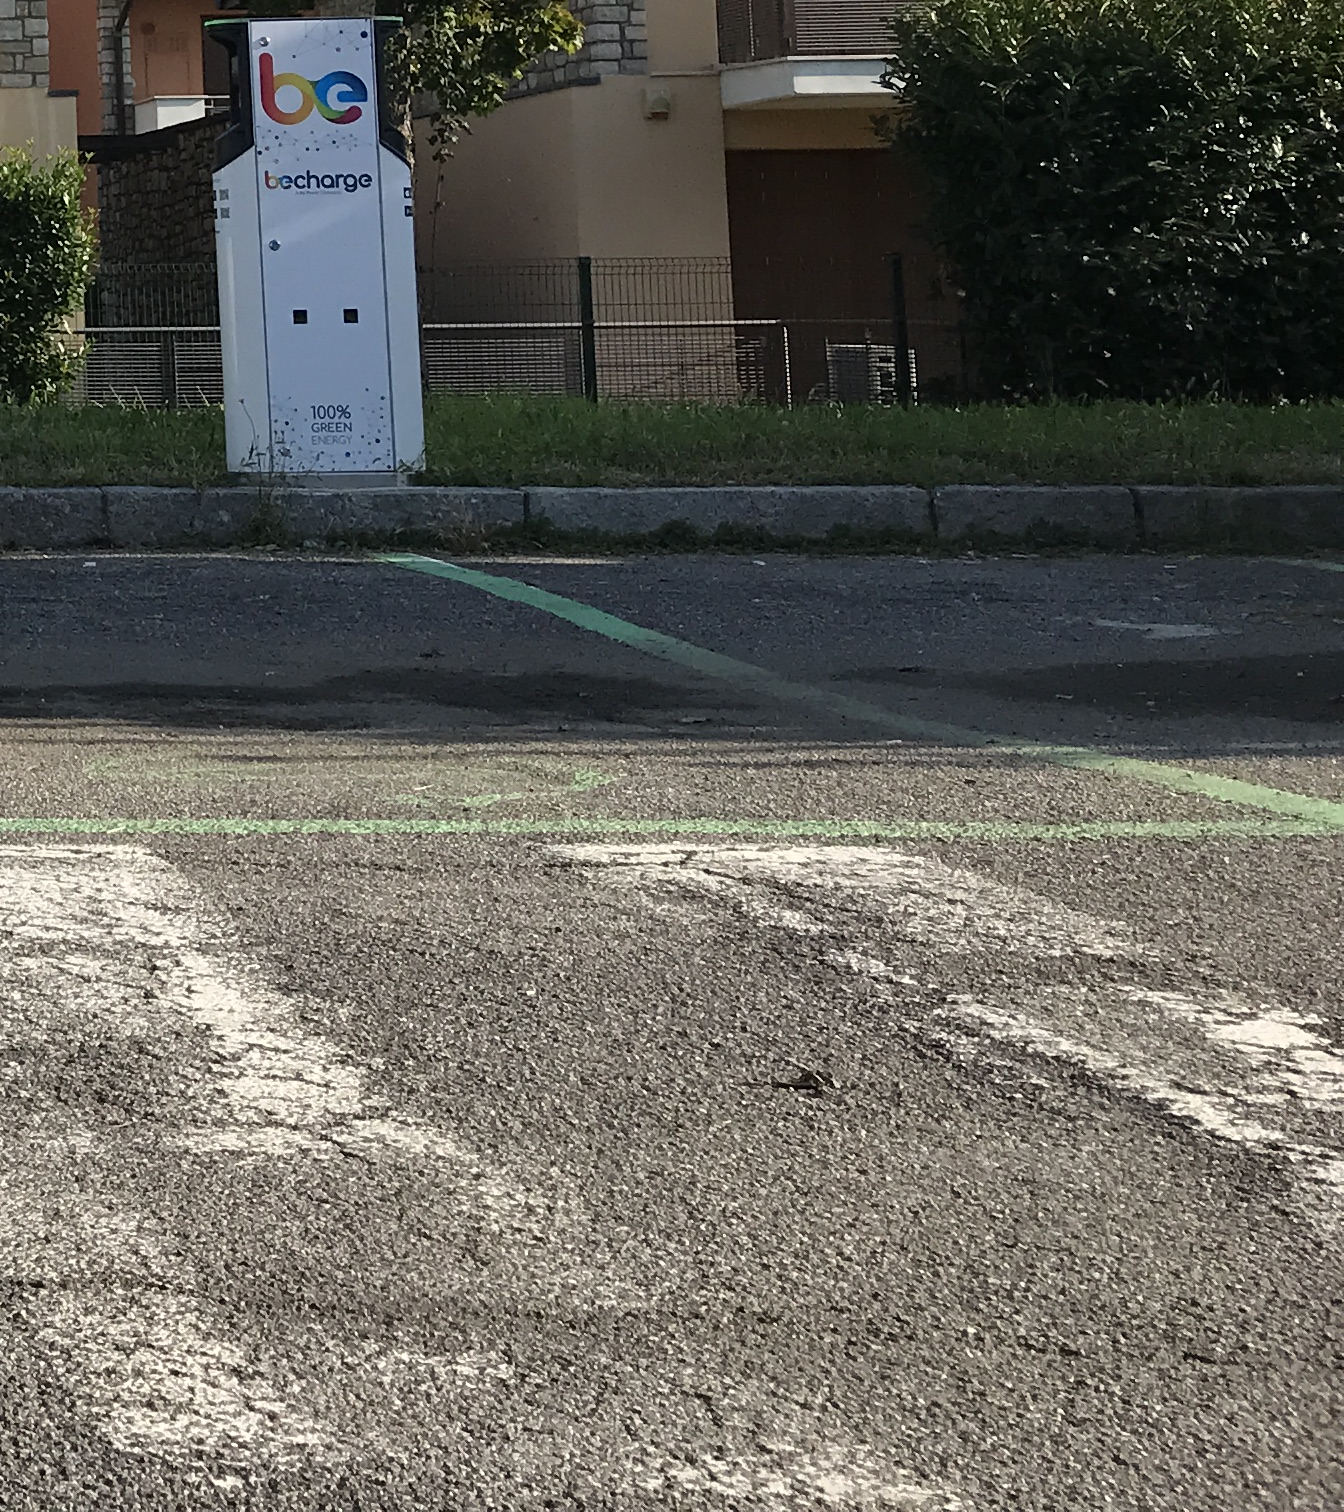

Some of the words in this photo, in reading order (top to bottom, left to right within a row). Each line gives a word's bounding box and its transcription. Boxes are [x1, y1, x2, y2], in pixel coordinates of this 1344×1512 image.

[258, 52, 368, 126] be
[264, 169, 373, 193] becharge
[310, 404, 352, 420] 100%
[310, 421, 353, 433] GREEN
[310, 434, 353, 445] ENERGY
